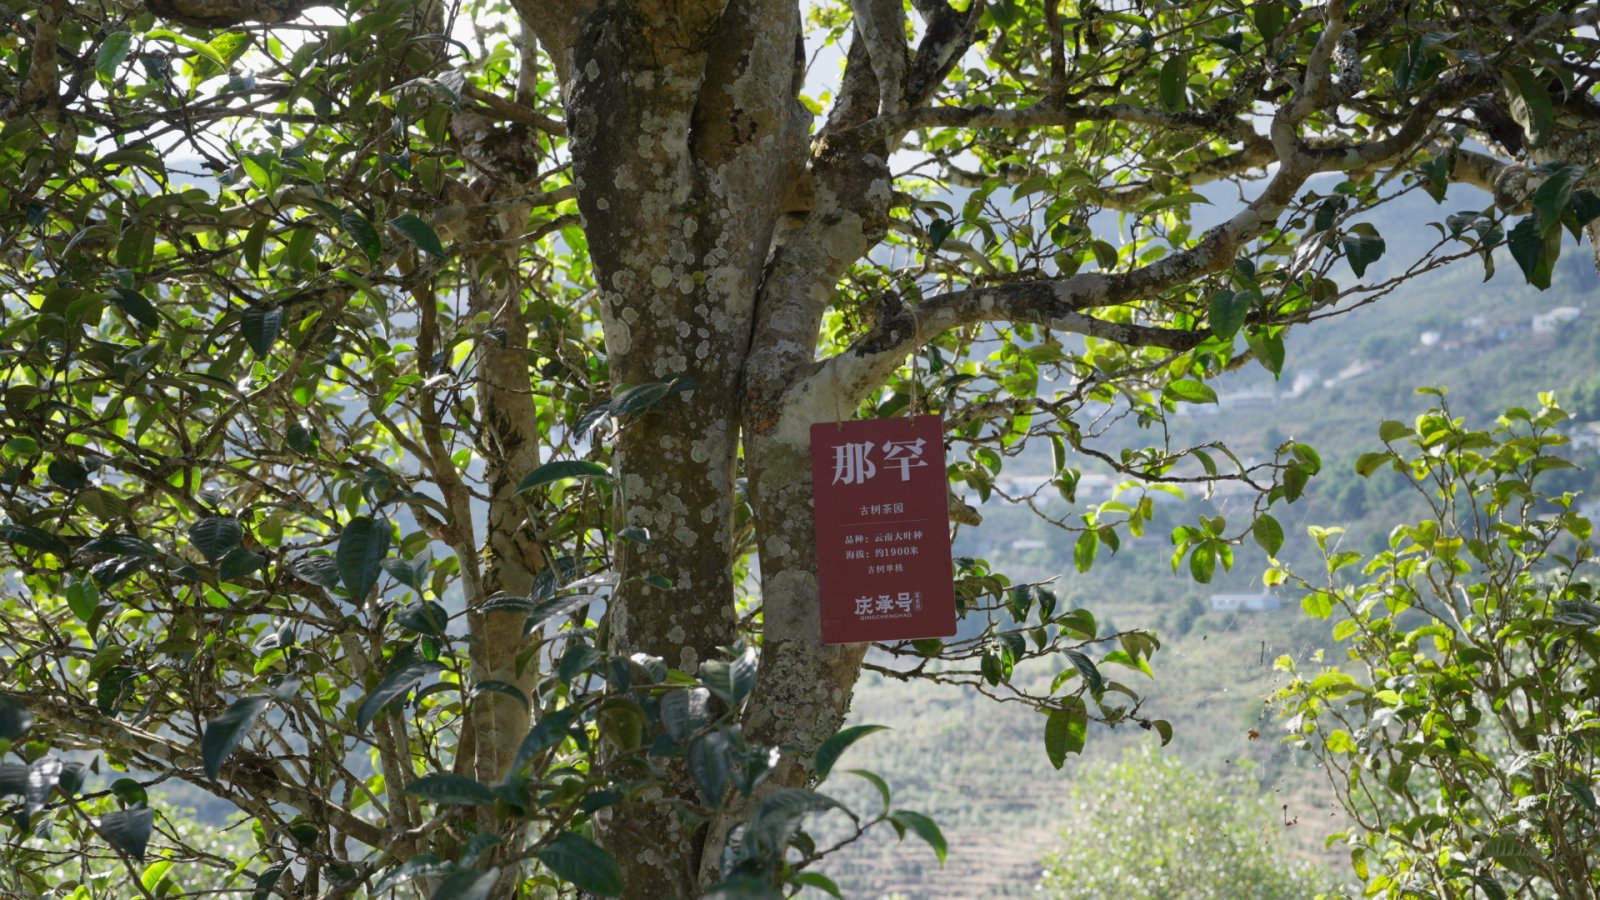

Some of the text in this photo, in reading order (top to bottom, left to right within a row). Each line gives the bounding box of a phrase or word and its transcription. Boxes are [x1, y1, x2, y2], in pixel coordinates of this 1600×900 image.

[831, 437, 928, 485] 那罕
[860, 502, 904, 516] 古树茶园
[867, 563, 904, 575] 古树单株
[854, 592, 912, 615] 庆承号
[859, 613, 912, 621] QINGCHENGHAO
